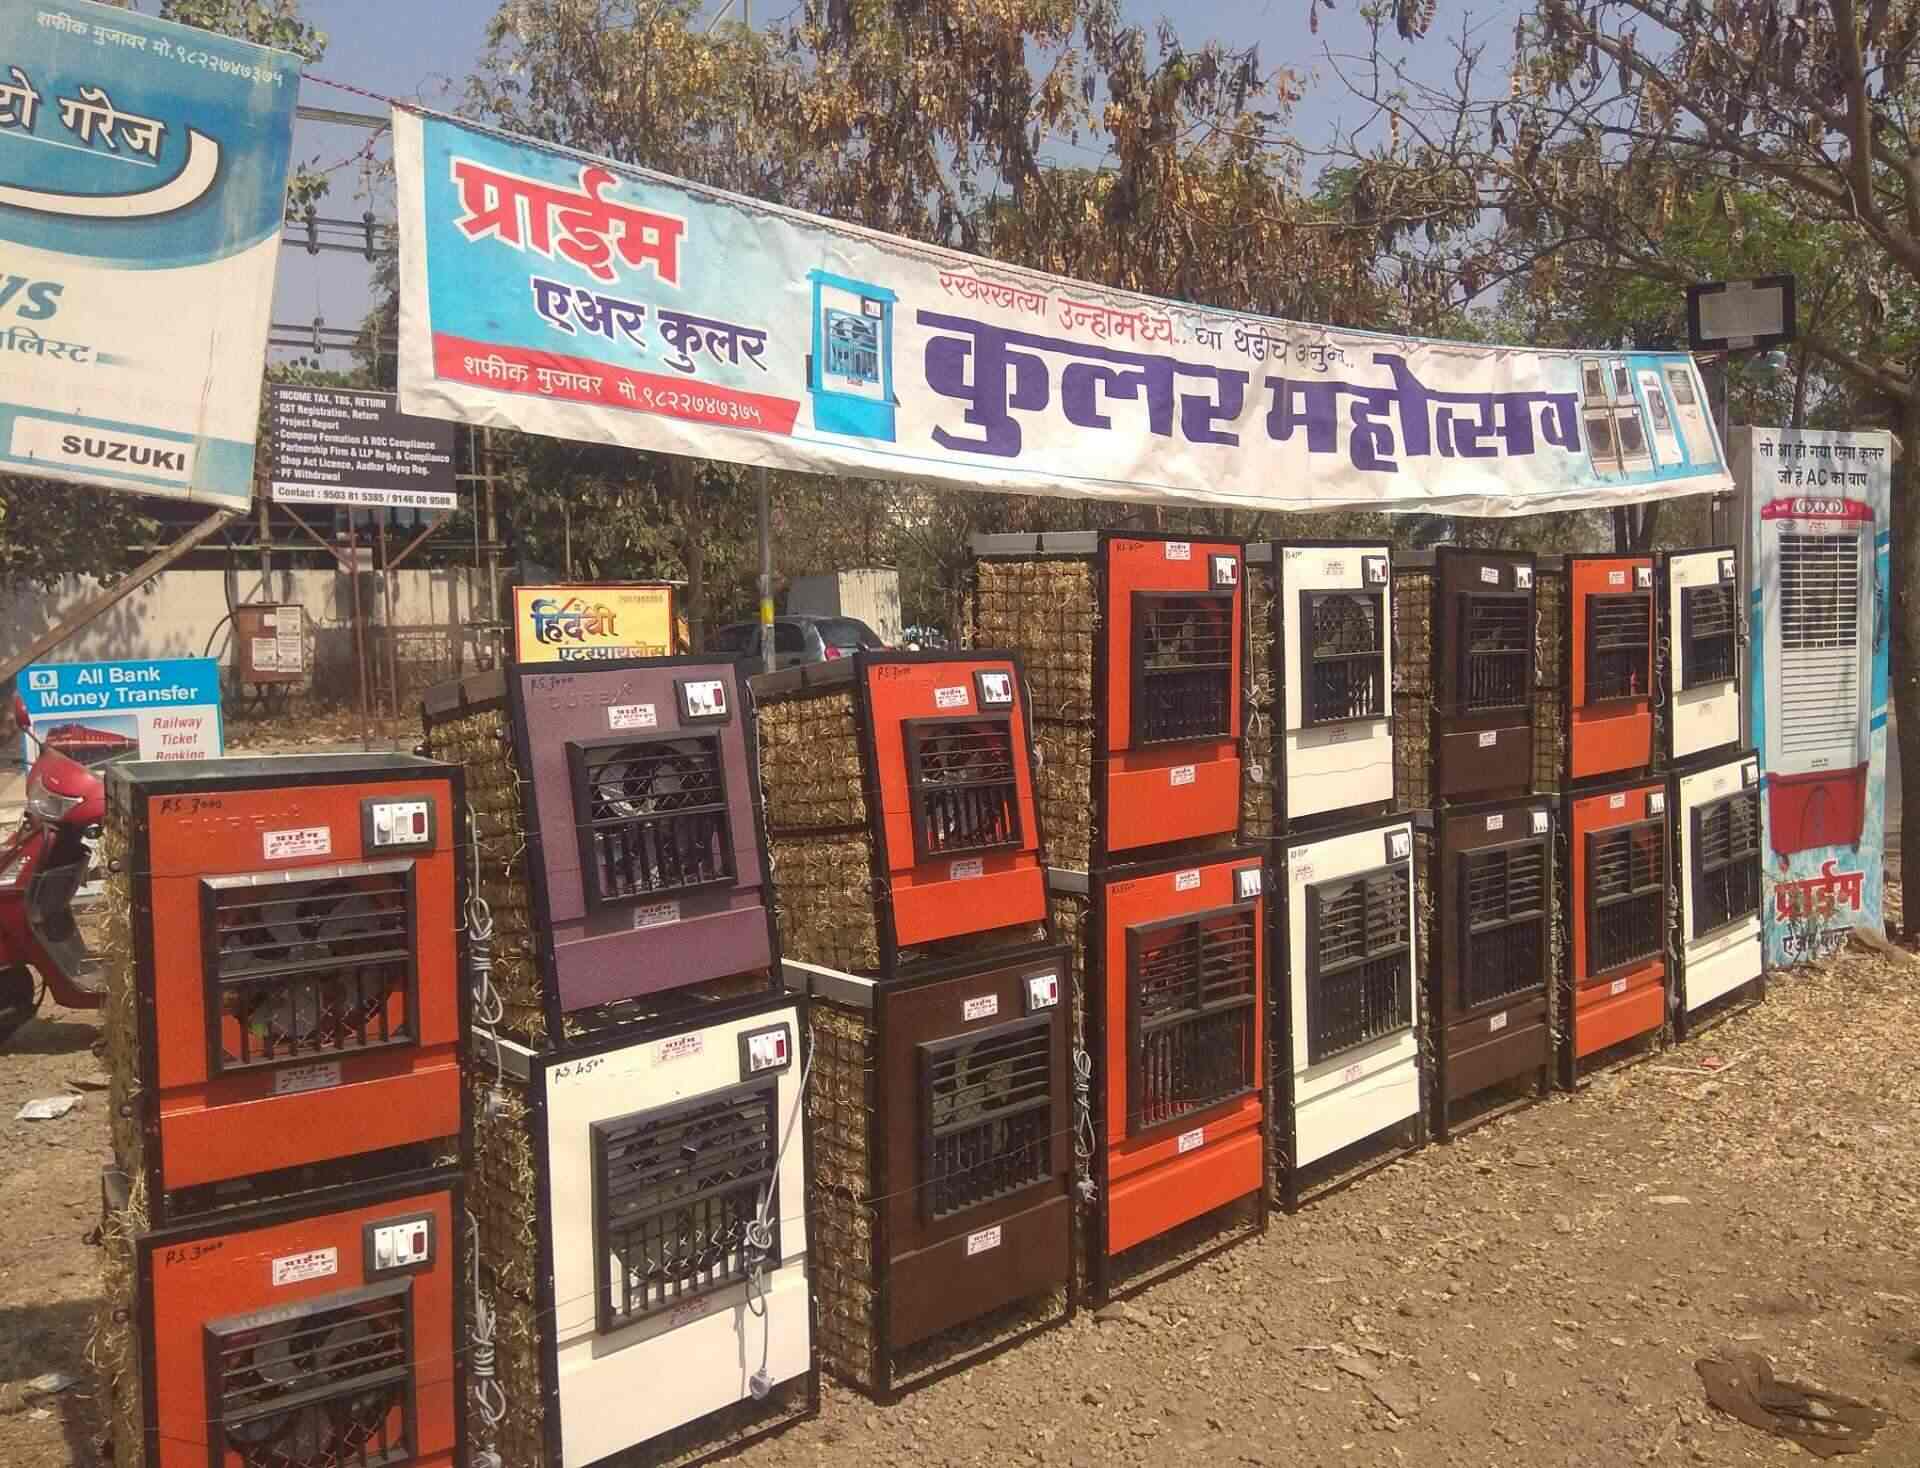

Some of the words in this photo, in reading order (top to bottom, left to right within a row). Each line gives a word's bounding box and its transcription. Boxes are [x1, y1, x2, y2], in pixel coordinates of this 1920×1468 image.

[453, 162, 684, 285] प्राईम
[533, 278, 646, 348] एअर
[657, 307, 768, 372] कुलर
[464, 353, 529, 385] शफीक
[536, 366, 602, 396] मुजावर
[280, 390, 312, 402] INCOME
[354, 396, 387, 409] RETURN
[280, 403, 295, 413] GST
[352, 409, 379, 419] Return
[280, 416, 311, 428] Project
[312, 419, 339, 430] Report
[280, 429, 317, 442] Company
[320, 432, 360, 444] Formation
[389, 438, 435, 450] Compliance
[62, 434, 184, 471] SUZUKI
[281, 442, 328, 456] Partnership
[330, 446, 349, 456] Firm
[359, 447, 374, 458] LLP
[404, 451, 450, 463] Compliance
[281, 455, 301, 467] Shop
[303, 457, 317, 466] Act
[294, 469, 340, 480] Withdrawal
[1806, 470, 1828, 486] AC
[278, 487, 314, 497] Contact
[77, 668, 102, 685] All
[109, 667, 161, 684] Bank
[41, 690, 110, 708] Money
[115, 686, 198, 703] Transfer
[152, 716, 203, 730] Railway
[161, 732, 198, 745] Ticket
